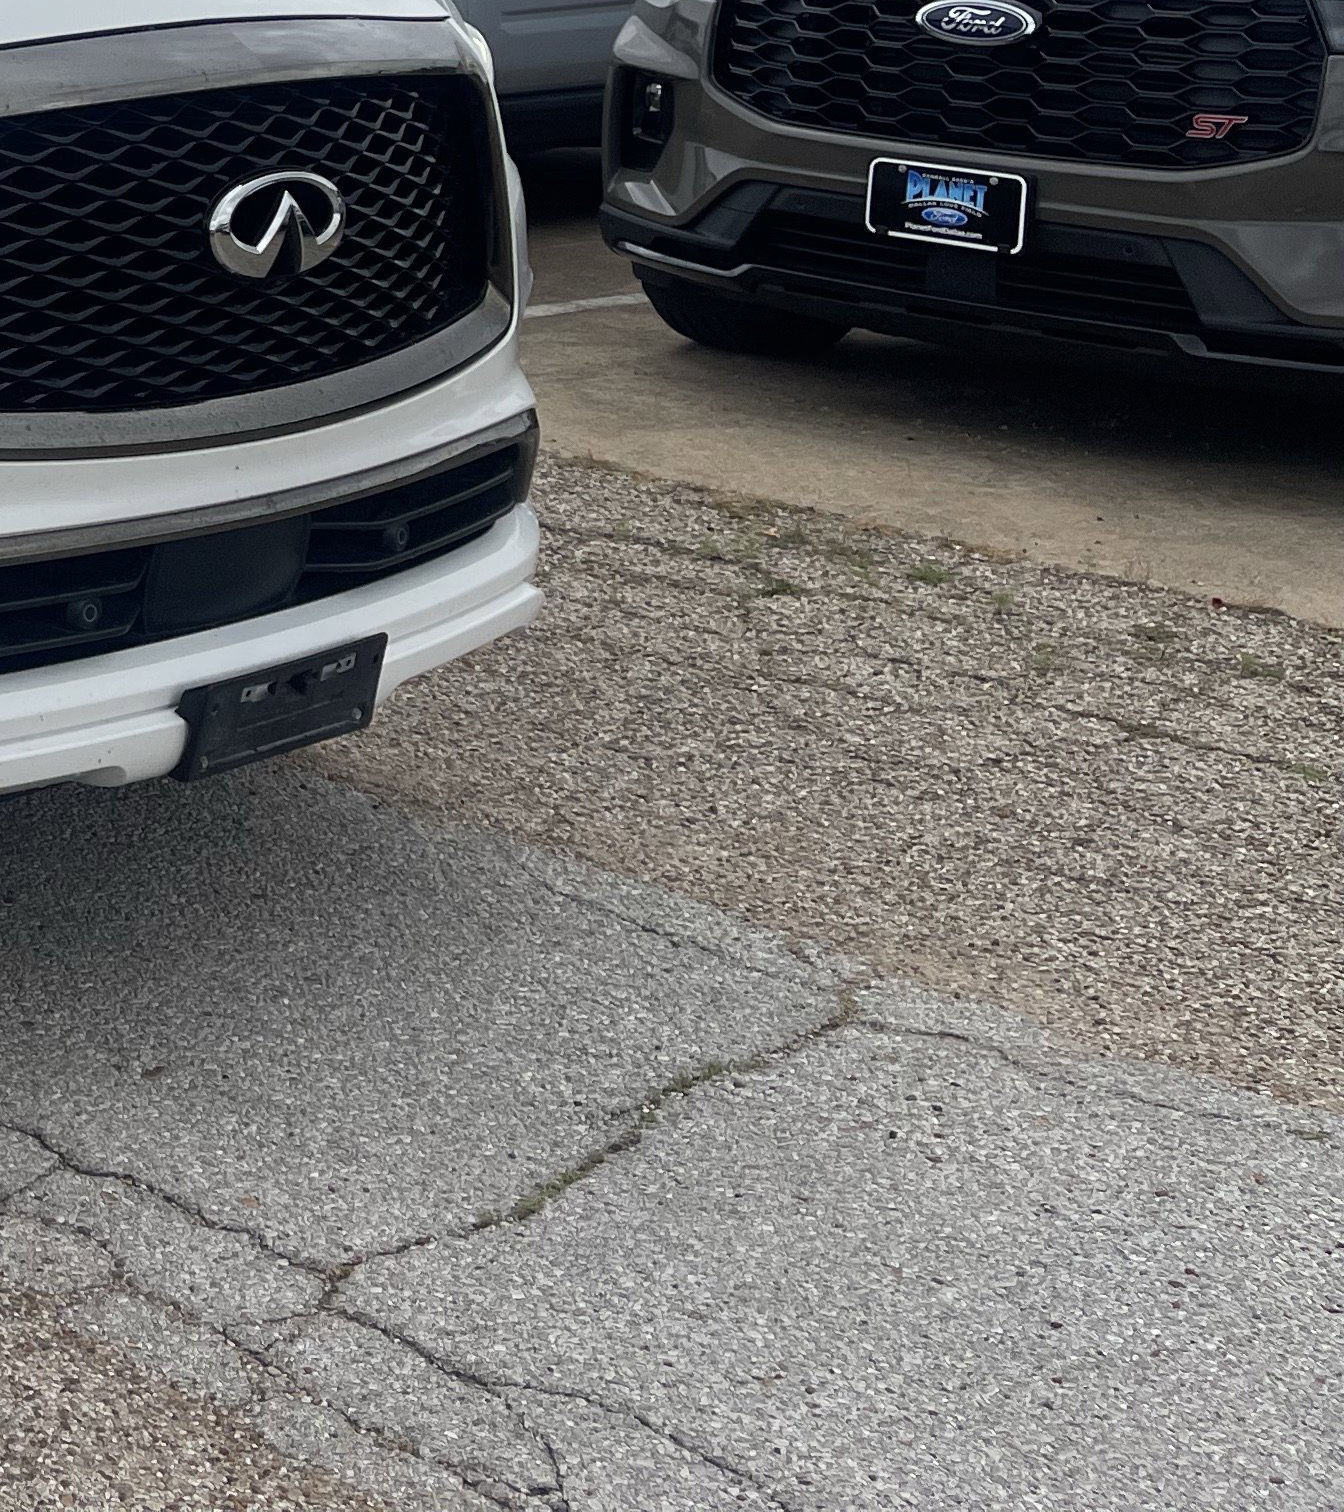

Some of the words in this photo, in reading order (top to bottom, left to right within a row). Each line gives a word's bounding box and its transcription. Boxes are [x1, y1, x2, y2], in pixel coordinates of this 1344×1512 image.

[941, 6, 1005, 35] Ford
[1187, 114, 1249, 139] ST
[906, 170, 987, 210] PLANET
